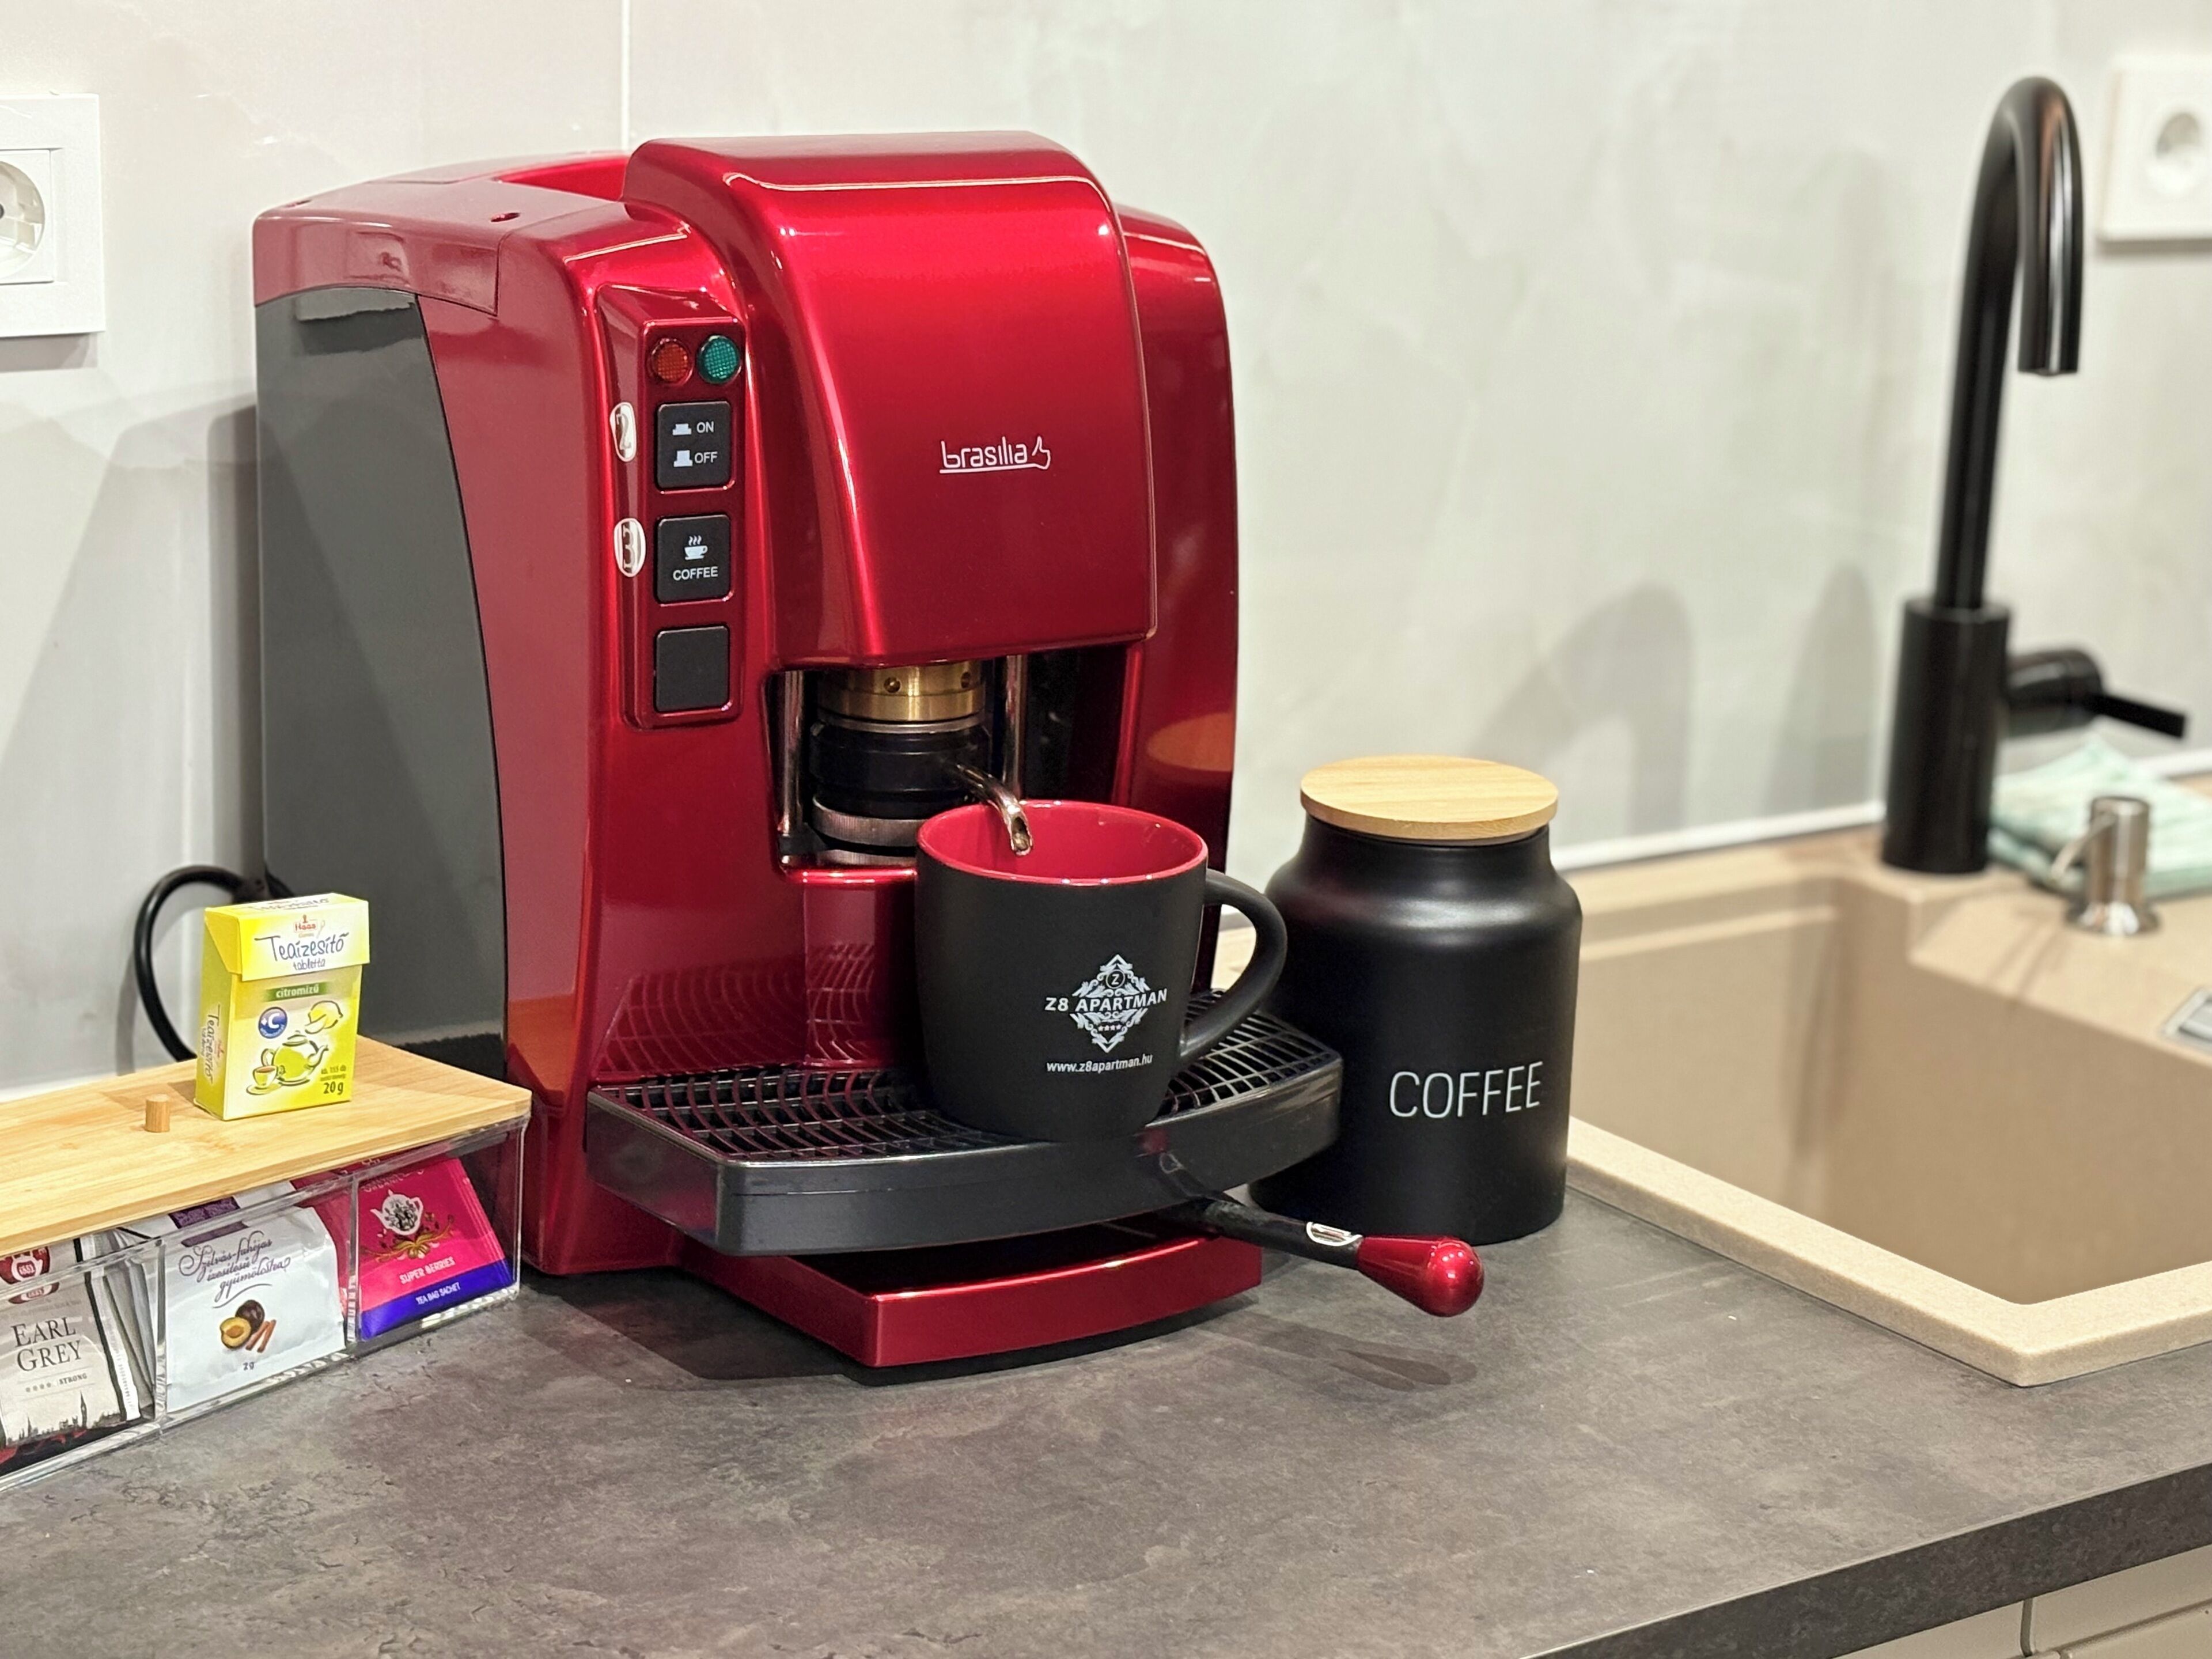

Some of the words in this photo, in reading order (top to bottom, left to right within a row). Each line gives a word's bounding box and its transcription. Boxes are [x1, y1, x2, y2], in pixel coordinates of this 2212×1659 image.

[696, 421, 714, 433] ON
[694, 451, 718, 464] OFF
[941, 436, 1028, 469] brasilia
[672, 566, 719, 581] COFFEE
[293, 957, 326, 971] tabletta
[1044, 997, 1069, 1012] Z8
[1075, 988, 1168, 1012] APARTMAN
[1046, 1053, 1153, 1074] www.z8apartman.hu
[323, 1081, 336, 1094] 20
[337, 1082, 344, 1096] g
[1389, 1060, 1543, 1119] COFFEE
[399, 1267, 426, 1285] SUPER
[424, 1256, 456, 1274] BERRIES
[415, 1296, 428, 1305] TEA
[426, 1290, 440, 1301] BAG
[438, 1282, 461, 1297] SACHET
[11, 1317, 77, 1348] EARL
[17, 1340, 82, 1372] GREY
[59, 1373, 88, 1385] STRONG
